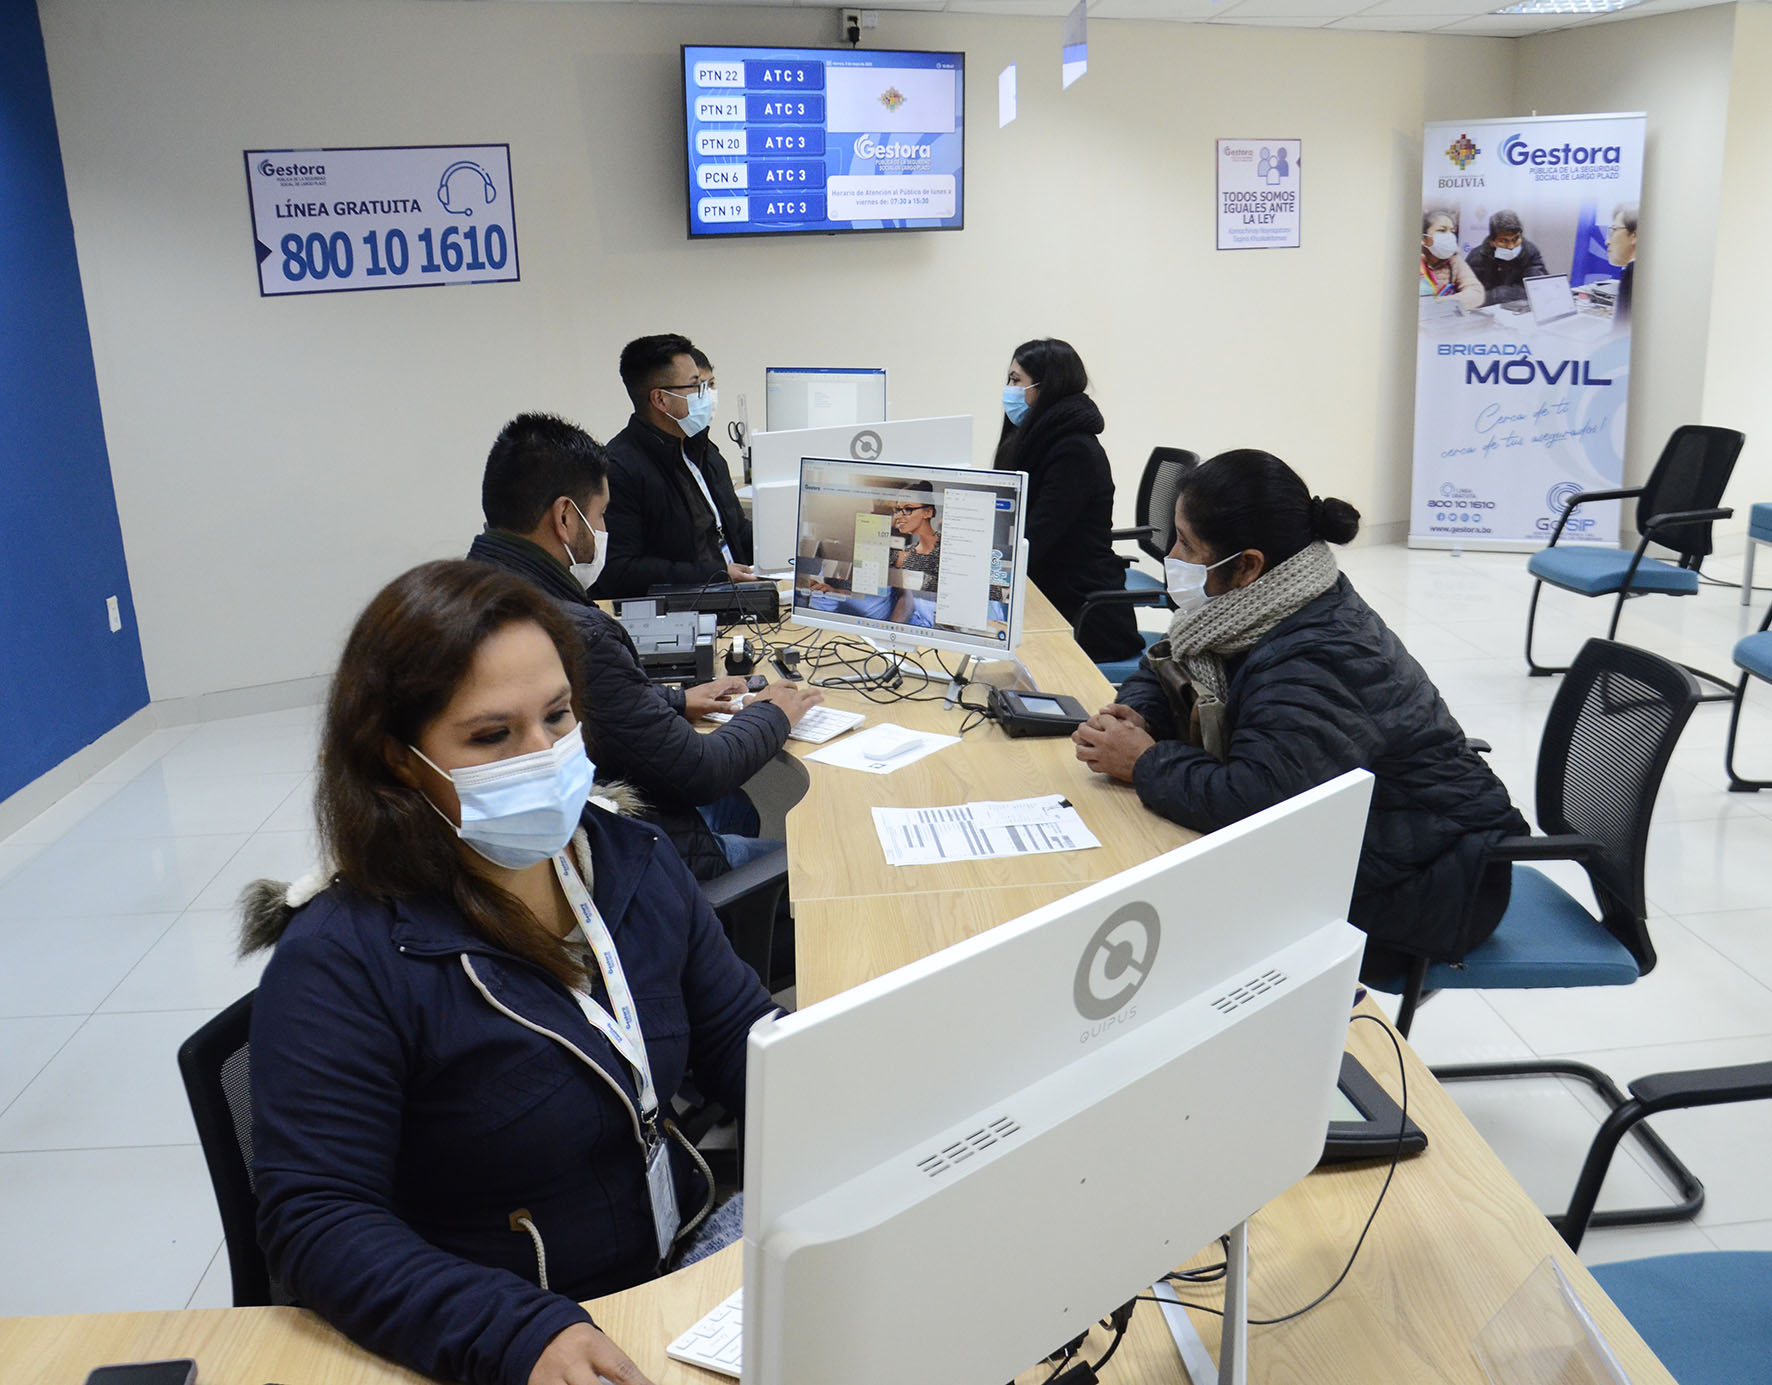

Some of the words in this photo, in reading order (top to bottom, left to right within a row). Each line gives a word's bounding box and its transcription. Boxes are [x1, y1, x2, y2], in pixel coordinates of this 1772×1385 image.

[700, 71, 722, 81] PTN
[726, 71, 738, 81] 22
[764, 70, 792, 81] ATC
[797, 70, 804, 81] 3
[701, 105, 722, 115] PTN
[727, 105, 738, 114] 21
[764, 104, 792, 115] ATC
[798, 104, 804, 115] 3
[702, 139, 723, 149] PTN
[728, 139, 739, 148] 20
[765, 137, 793, 148] ATC
[798, 137, 805, 148] 3
[859, 138, 930, 159] Gestora
[1506, 141, 1620, 166] Gestora
[262, 162, 325, 176] Gestora
[705, 172, 729, 183] PCN
[732, 172, 738, 182] 6
[766, 170, 794, 181] ATC
[799, 170, 806, 181] 3
[1438, 179, 1485, 188] BOLIVIA
[1223, 192, 1257, 202] TODOS
[1260, 191, 1295, 201] SOMOS
[276, 199, 329, 218] LÍNEA
[334, 199, 421, 216] GRATUITA
[704, 206, 726, 216] PTN
[730, 206, 741, 216] 19
[767, 203, 794, 214] ATC
[800, 202, 806, 213] 3
[1224, 203, 1267, 213] IGUALES
[1269, 202, 1294, 212] ANTE
[1243, 214, 1255, 224] LA
[1258, 214, 1276, 224] LEY
[280, 231, 354, 281] 800
[362, 228, 409, 276] 10
[418, 224, 508, 273] 1610
[1437, 344, 1532, 356] BRIGADA
[1465, 355, 1612, 385] MÓVIL
[1475, 403, 1526, 433] Cerca
[1533, 402, 1548, 425] de
[1441, 448, 1476, 458] cerca
[1482, 435, 1499, 458] de
[1501, 430, 1524, 447] tus
[1079, 1006, 1137, 1044] QUIPUS
